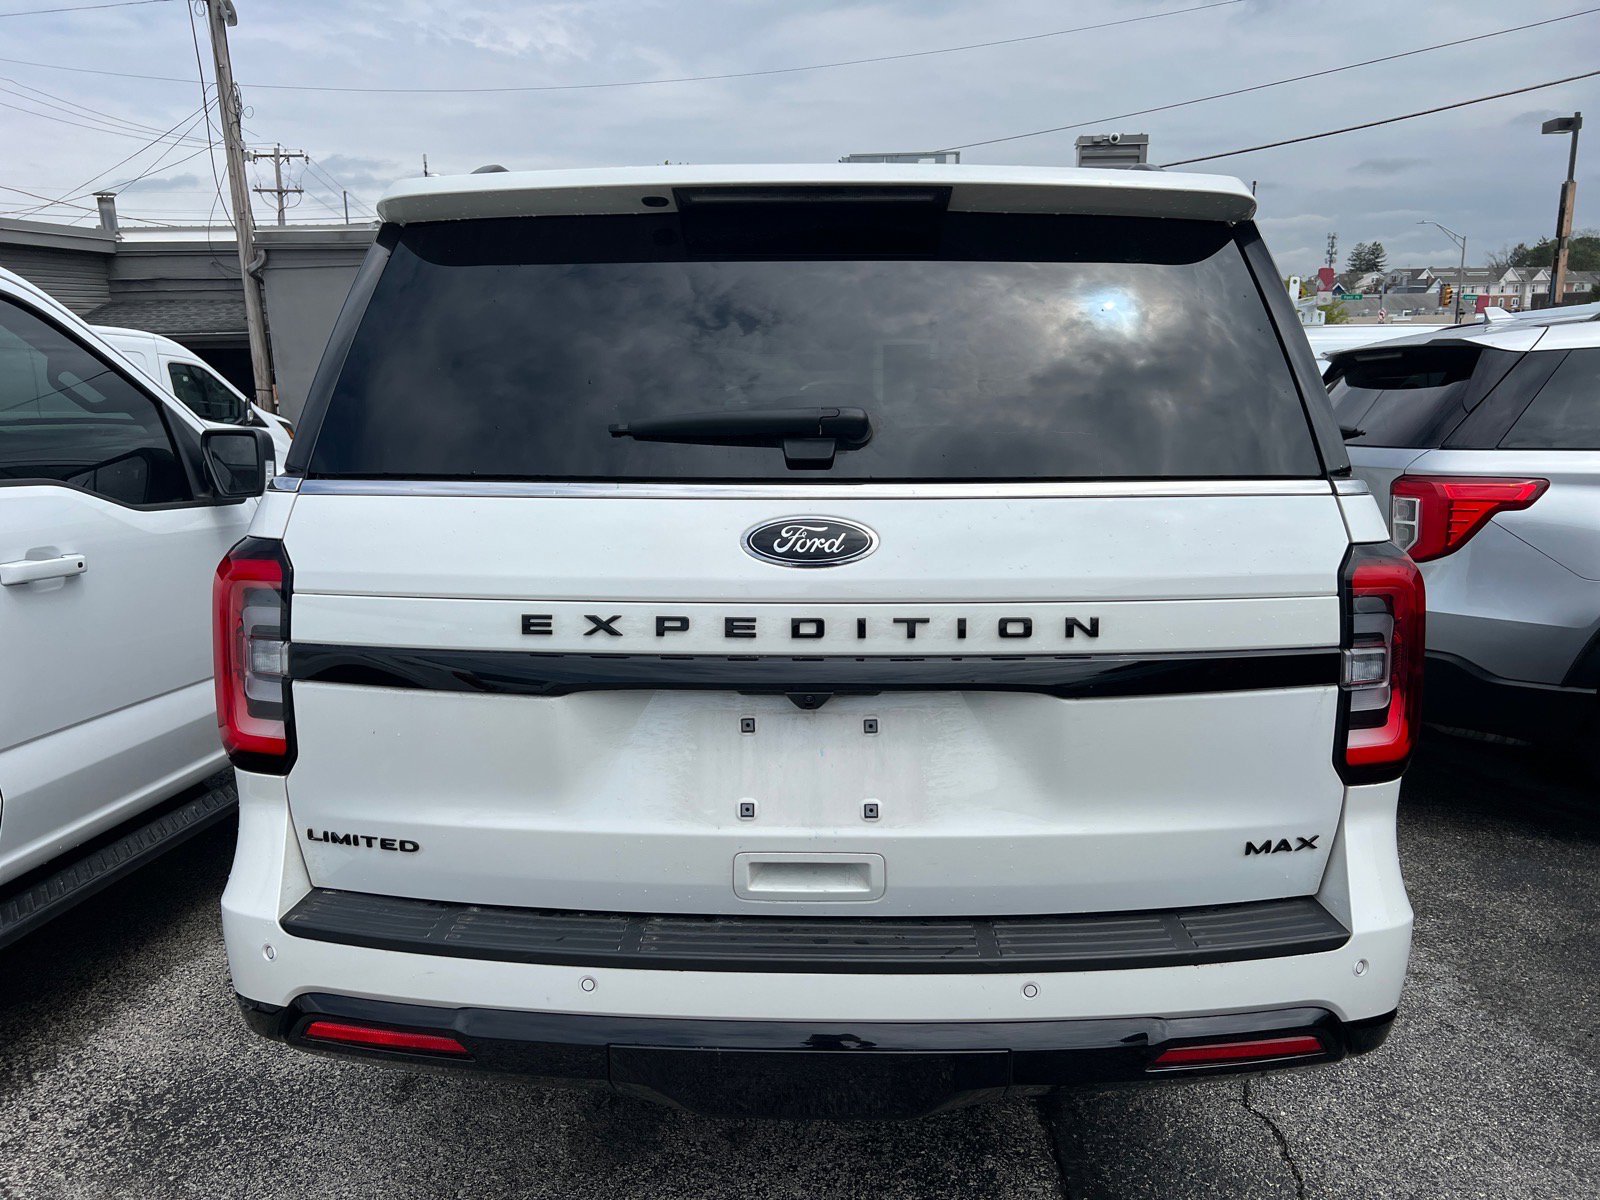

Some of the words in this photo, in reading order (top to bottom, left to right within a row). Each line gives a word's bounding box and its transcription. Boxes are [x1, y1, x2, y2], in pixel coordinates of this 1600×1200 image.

[773, 525, 847, 553] Ford
[521, 613, 1100, 640] EXPEDITION
[307, 828, 420, 853] LIMITED
[1244, 834, 1320, 856] MAX
